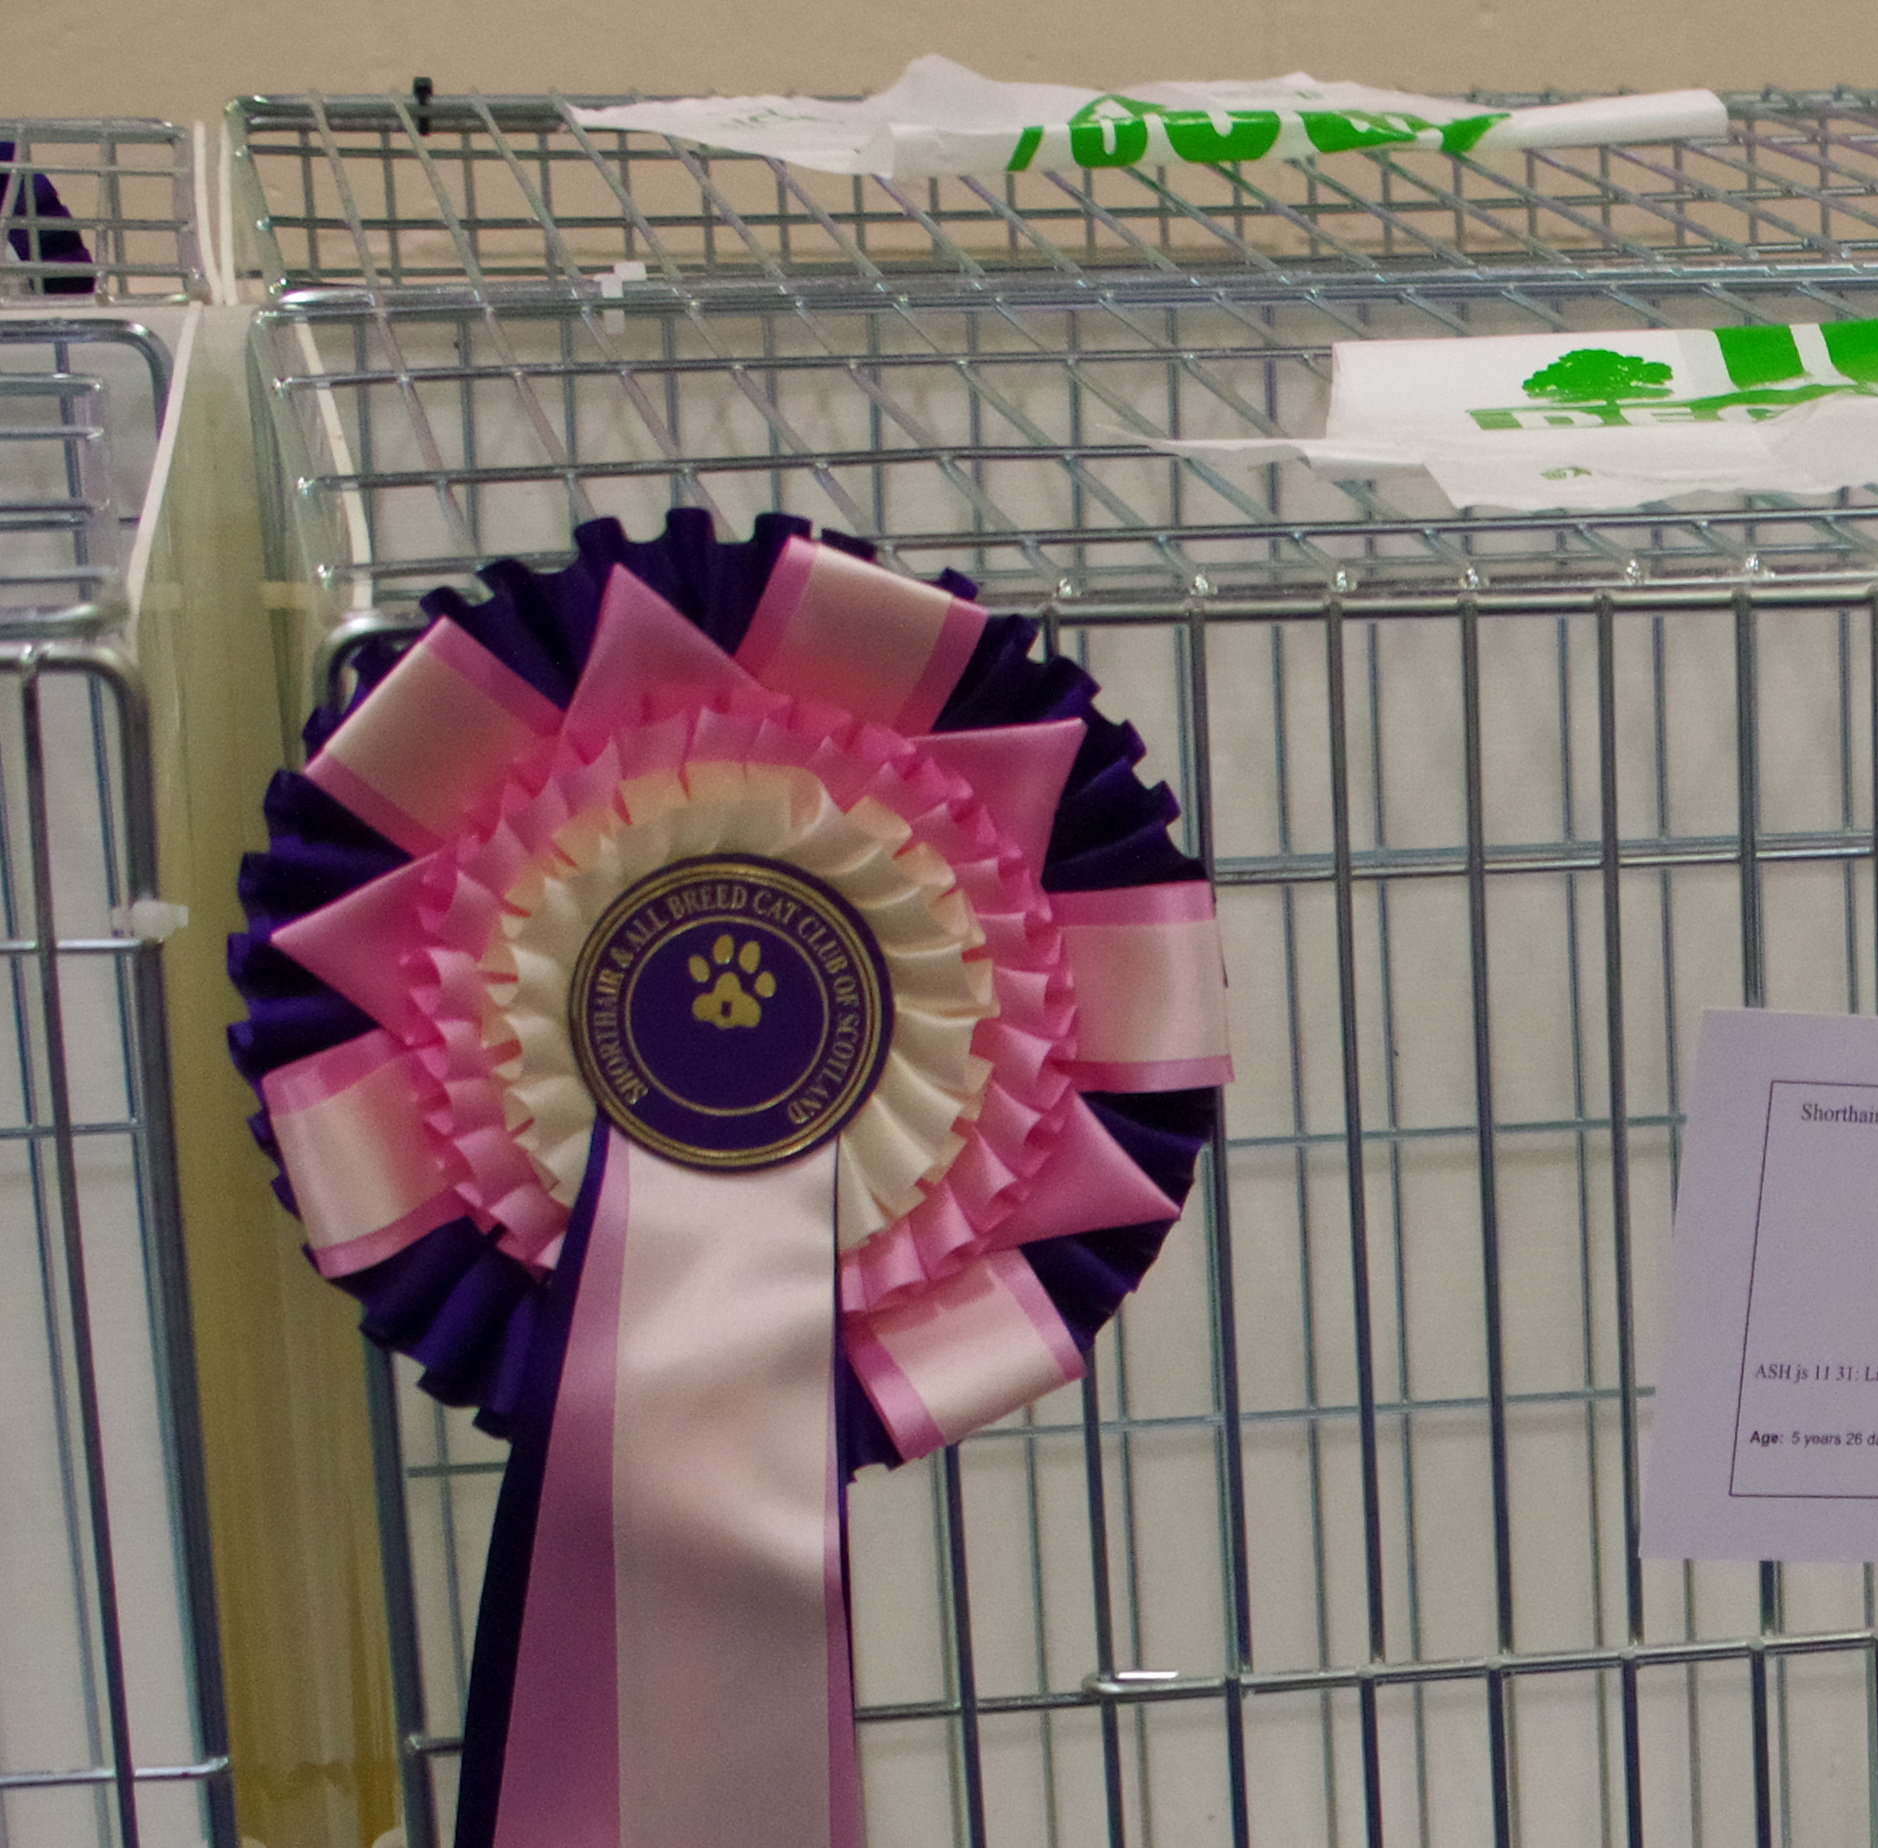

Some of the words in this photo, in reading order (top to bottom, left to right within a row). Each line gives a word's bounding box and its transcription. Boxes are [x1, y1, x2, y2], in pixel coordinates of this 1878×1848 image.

[666, 884, 748, 920] BREED
[752, 888, 802, 925] CAT
[626, 908, 669, 951] ALL
[799, 915, 847, 974] CLUB
[610, 948, 634, 969] &
[833, 974, 860, 1010] OF
[786, 1011, 861, 1125] SCOTLAND
[1754, 1364, 1792, 1381] ASH
[1814, 1364, 1830, 1381] 11
[1750, 1431, 1785, 1447] Age:
[1791, 1432, 1800, 1445] 5
[1803, 1432, 1842, 1448] years
[1846, 1432, 1863, 1446] 26
